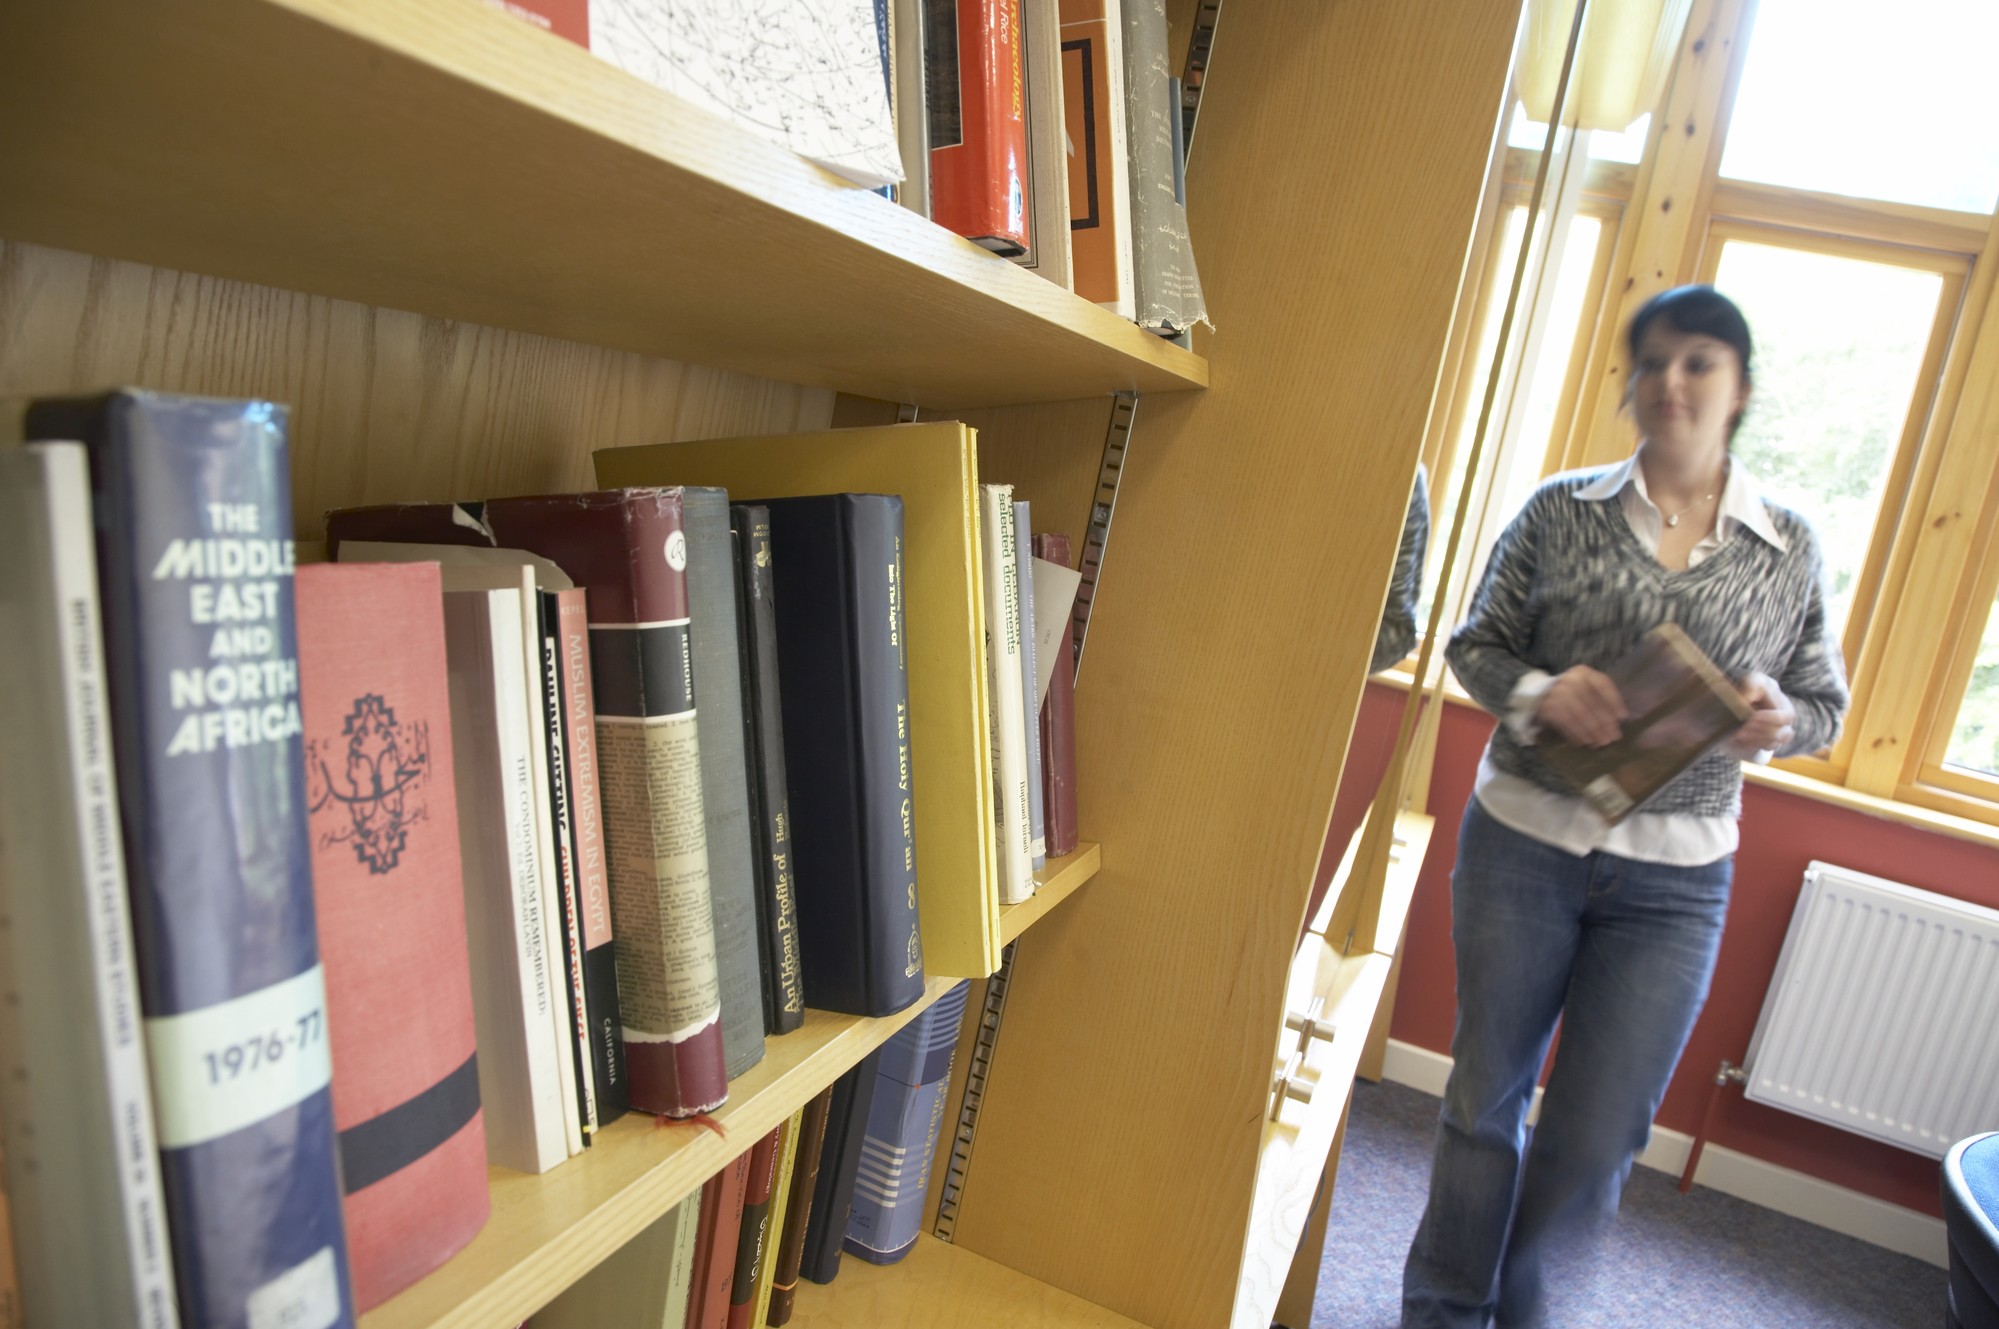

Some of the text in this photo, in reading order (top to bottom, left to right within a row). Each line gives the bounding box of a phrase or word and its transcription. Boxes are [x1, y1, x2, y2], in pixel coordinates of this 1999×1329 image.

[1000, 11, 1009, 44] Rice
[1010, 0, 1021, 121] rchaeology
[207, 502, 261, 533] THE
[152, 538, 296, 580] MIDDLE
[998, 493, 1015, 655] selected documents
[190, 583, 280, 623] EAST
[889, 606, 897, 631] Light
[209, 627, 272, 659] AND
[891, 632, 898, 646] Of
[170, 658, 297, 709] NORTH
[681, 633, 692, 702] REDHOUSE
[166, 701, 303, 757] AFRICA
[897, 699, 906, 740] The
[569, 634, 605, 932] MUSLIM EXTREMISM IN EGYPT
[898, 743, 908, 791] Holy
[1019, 781, 1027, 820] Raphael
[775, 813, 785, 843] Hugh
[517, 756, 546, 1016] THE CONDOMINIUM REMEMBERED:
[519, 870, 528, 923] DEBORAH
[907, 882, 916, 910] 8
[523, 925, 532, 958] LAVIN
[773, 853, 797, 1013] An Urban Profile of
[202, 1007, 324, 1086] 1976-77
[604, 1017, 616, 1085] CALIFORNIA
[917, 1081, 944, 1190] IRAN STATISTICAL
